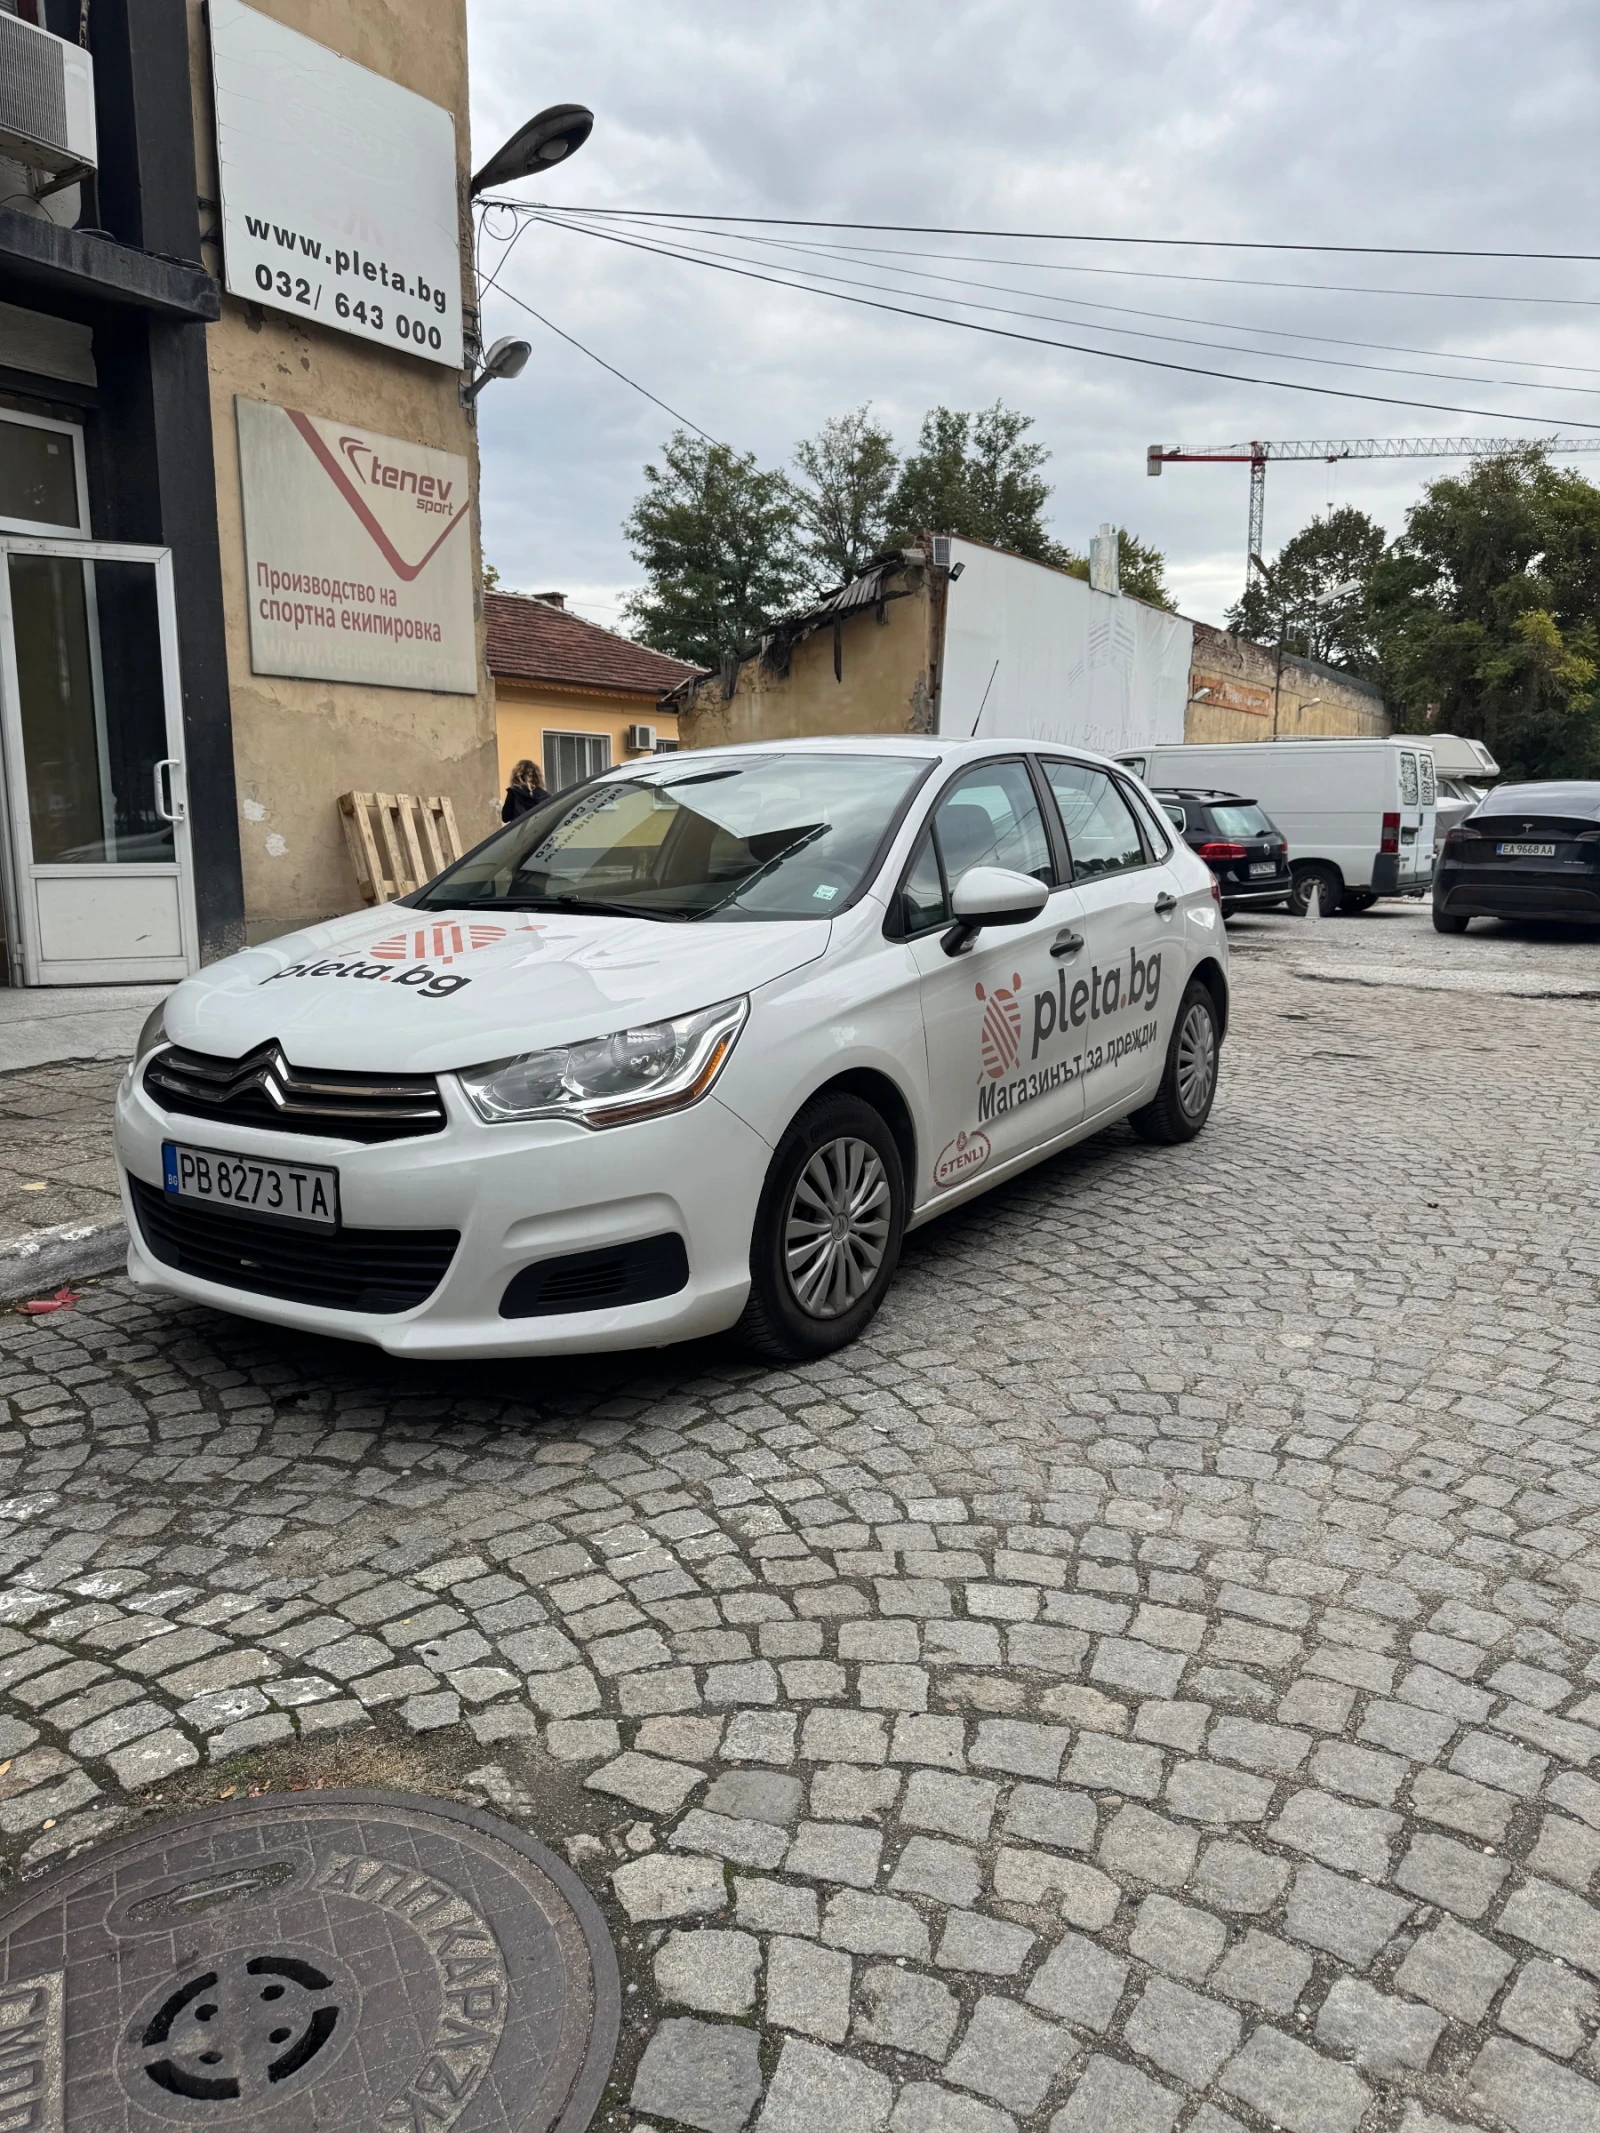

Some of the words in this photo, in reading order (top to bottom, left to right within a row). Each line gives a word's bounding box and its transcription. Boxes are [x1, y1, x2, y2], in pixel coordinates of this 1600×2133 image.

[244, 214, 447, 315] www.pleta.bg
[255, 263, 322, 311] 032/
[335, 292, 384, 330] 643
[395, 314, 442, 350] 000
[370, 455, 453, 502] tenev
[416, 498, 454, 516] sport
[256, 561, 376, 604] Производство
[379, 587, 398, 608] на
[259, 598, 336, 630] спортна
[340, 608, 442, 643] екипировка
[1502, 844, 1515, 854] EA
[1516, 844, 1540, 854] 9668
[1540, 845, 1553, 855] AA
[257, 959, 473, 999] pleta.bg
[1030, 945, 1162, 1061] pleta.bg
[977, 1054, 1083, 1123] Магазинът
[1085, 1045, 1103, 1074] за
[1105, 1019, 1158, 1068] прежди
[168, 1173, 178, 1187] BG
[179, 1153, 213, 1194] PB
[217, 1161, 284, 1208] 8273
[288, 1172, 329, 1217] TA
[940, 1145, 984, 1178] STENLI
